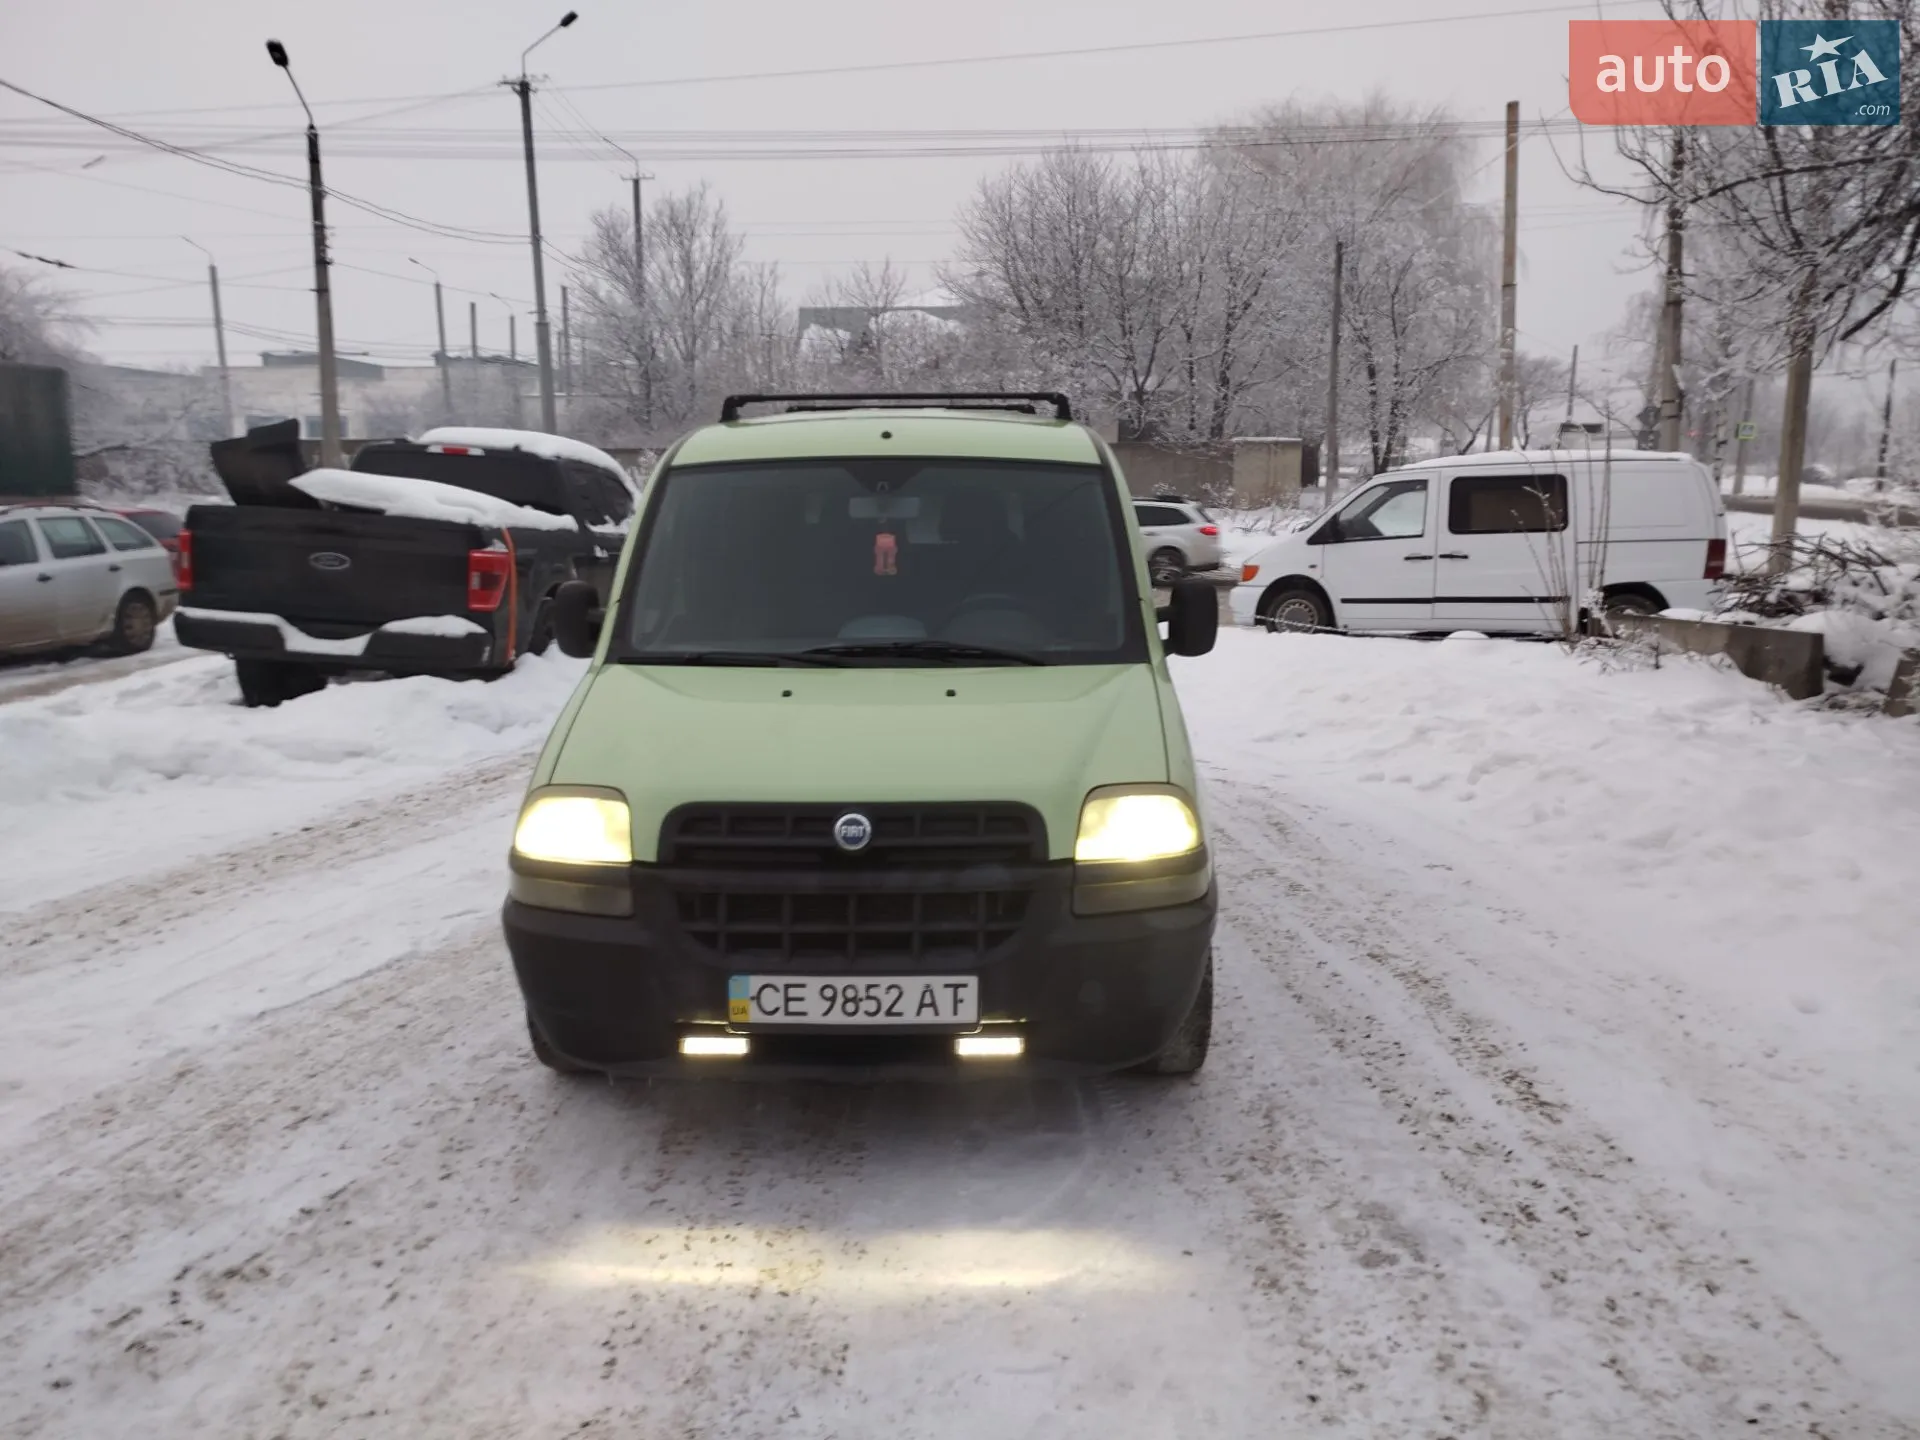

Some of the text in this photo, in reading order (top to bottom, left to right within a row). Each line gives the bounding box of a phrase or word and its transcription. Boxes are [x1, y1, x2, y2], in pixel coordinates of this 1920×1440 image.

[755, 983, 969, 1017] CE 9852 AT
